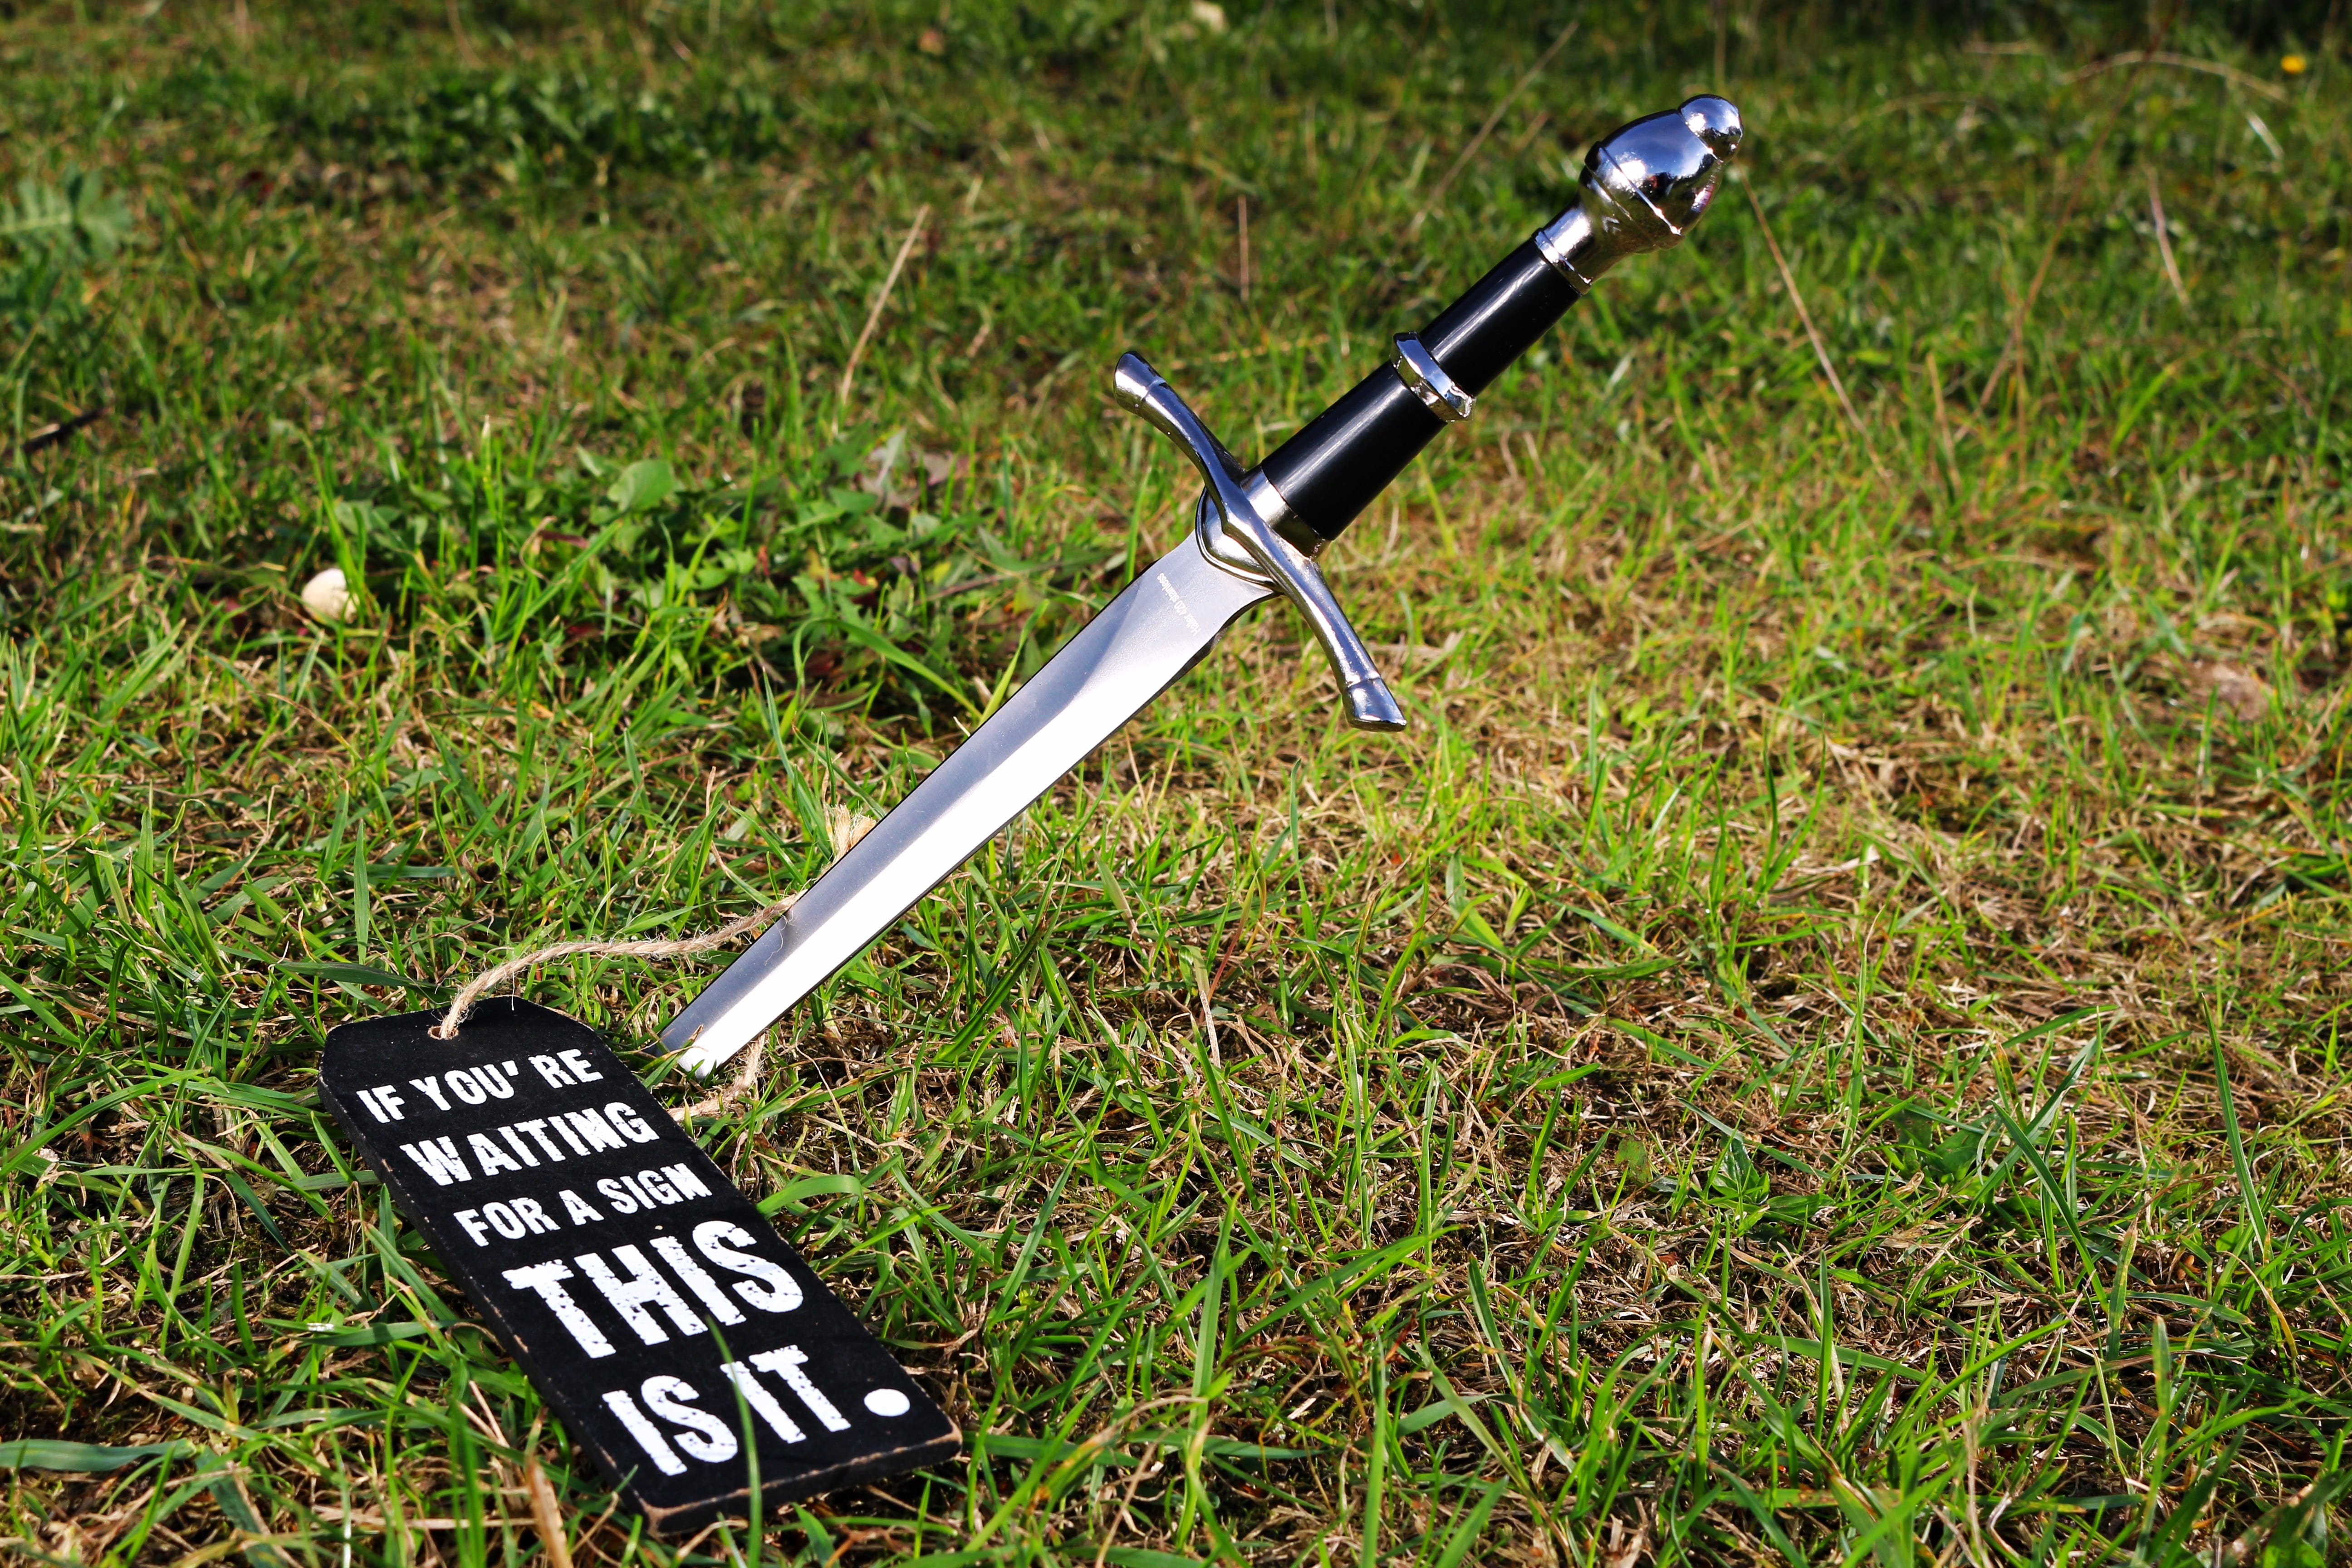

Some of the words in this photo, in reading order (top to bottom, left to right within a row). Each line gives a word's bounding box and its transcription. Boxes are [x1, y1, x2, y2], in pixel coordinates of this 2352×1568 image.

[1156, 573, 1180, 602] stainless
[1174, 599, 1187, 616] 420
[1184, 612, 1202, 636] Haller
[356, 1085, 405, 1123] IF
[400, 1102, 659, 1186] WAITING
[453, 1197, 560, 1246] FOR
[559, 1190, 604, 1225] A
[597, 1163, 712, 1214] SIGN
[502, 1221, 803, 1358] THIS
[602, 1375, 738, 1475] IS
